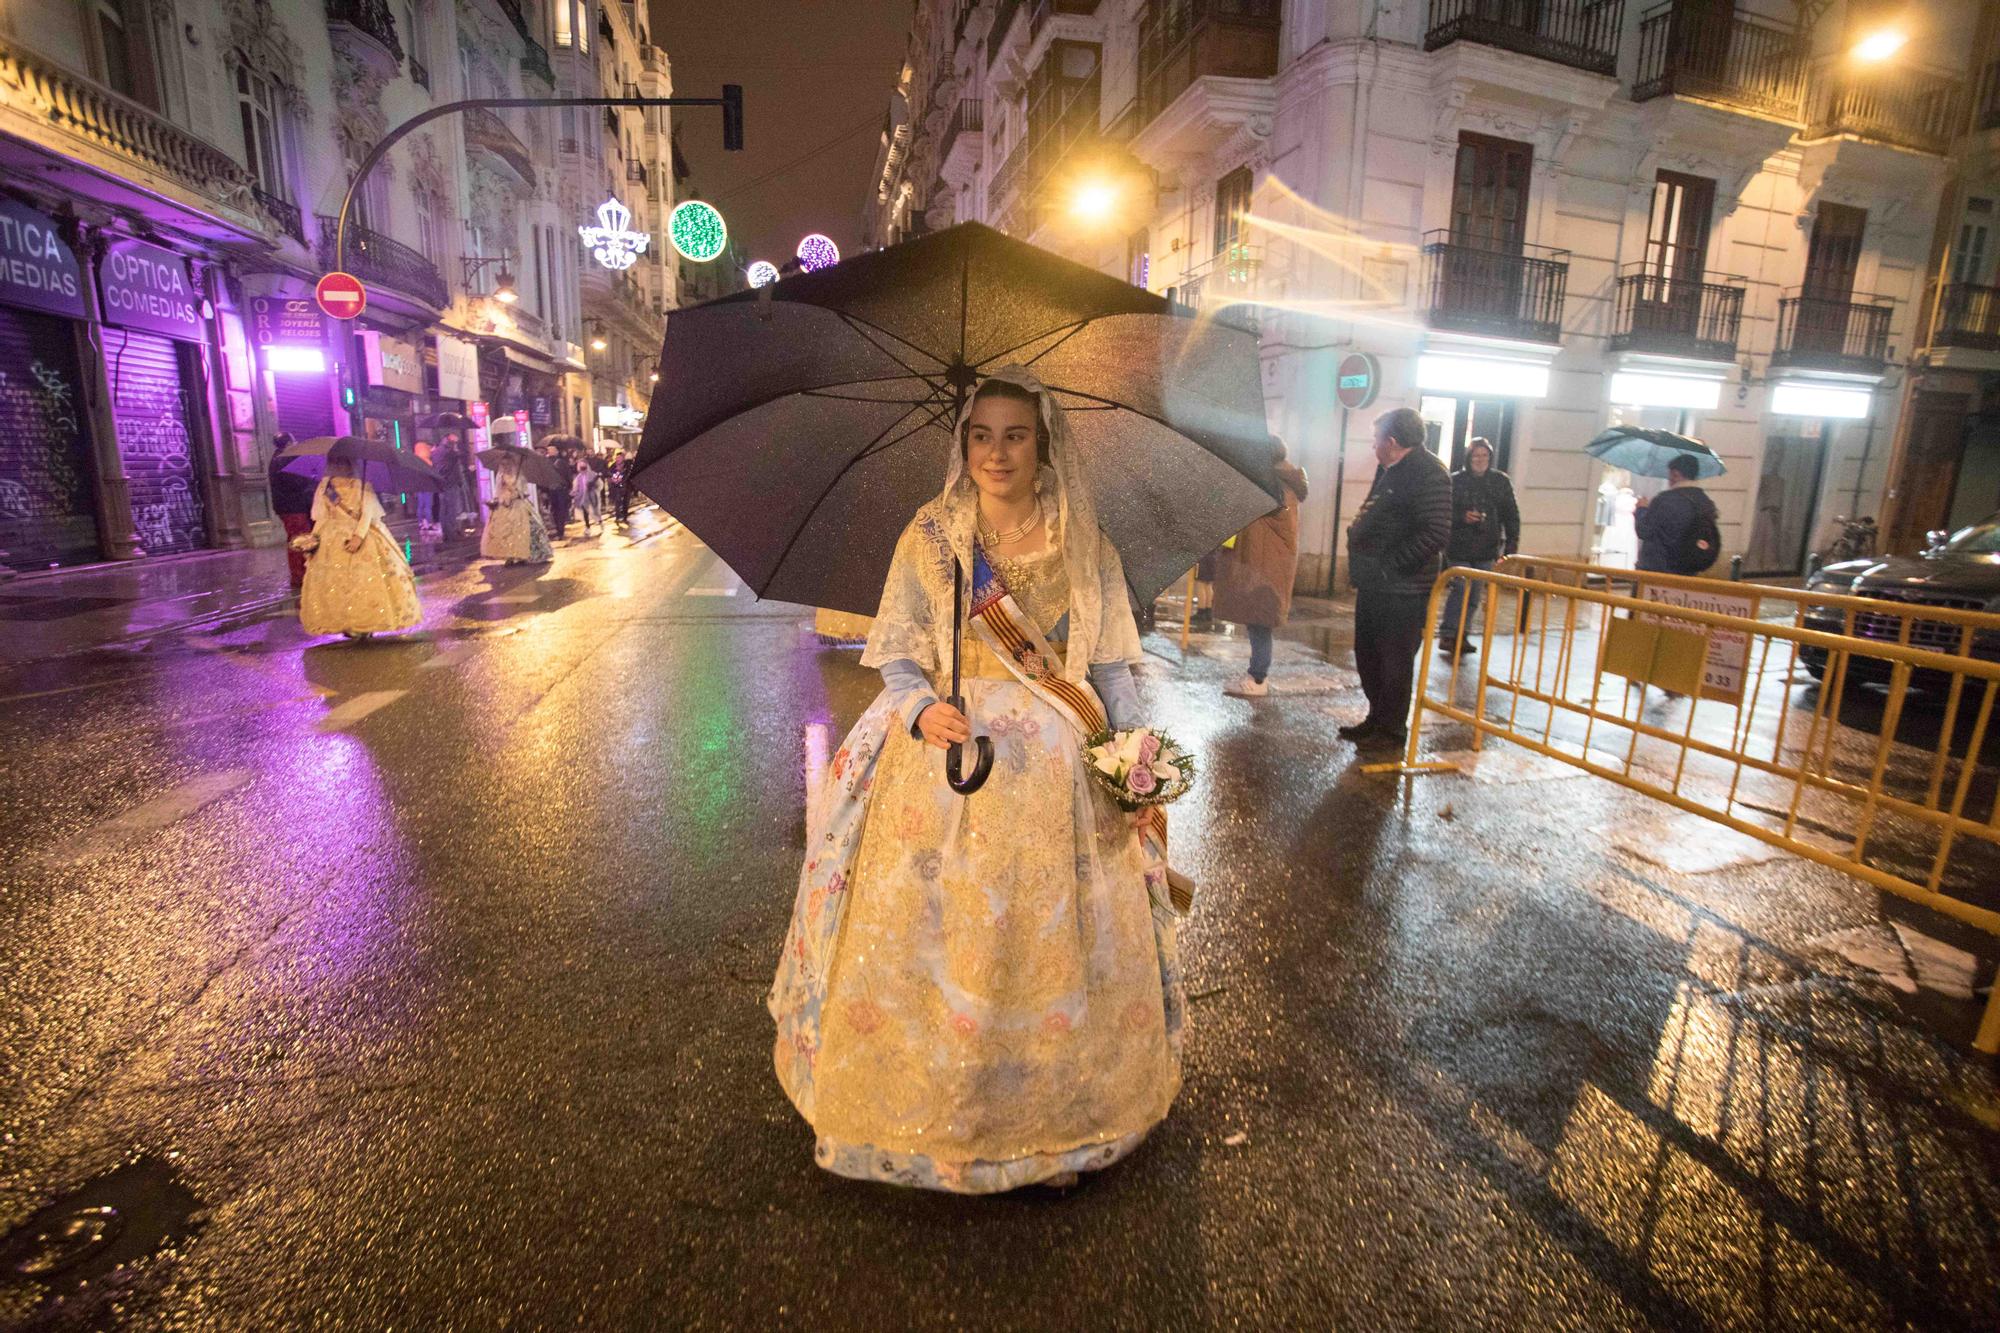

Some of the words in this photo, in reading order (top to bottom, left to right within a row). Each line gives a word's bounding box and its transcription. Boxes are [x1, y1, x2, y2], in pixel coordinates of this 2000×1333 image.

[110, 250, 185, 296] OPTICA
[107, 285, 196, 324] COMEDIAS
[254, 298, 273, 344] ORO
[280, 329, 321, 337] RELOJES
